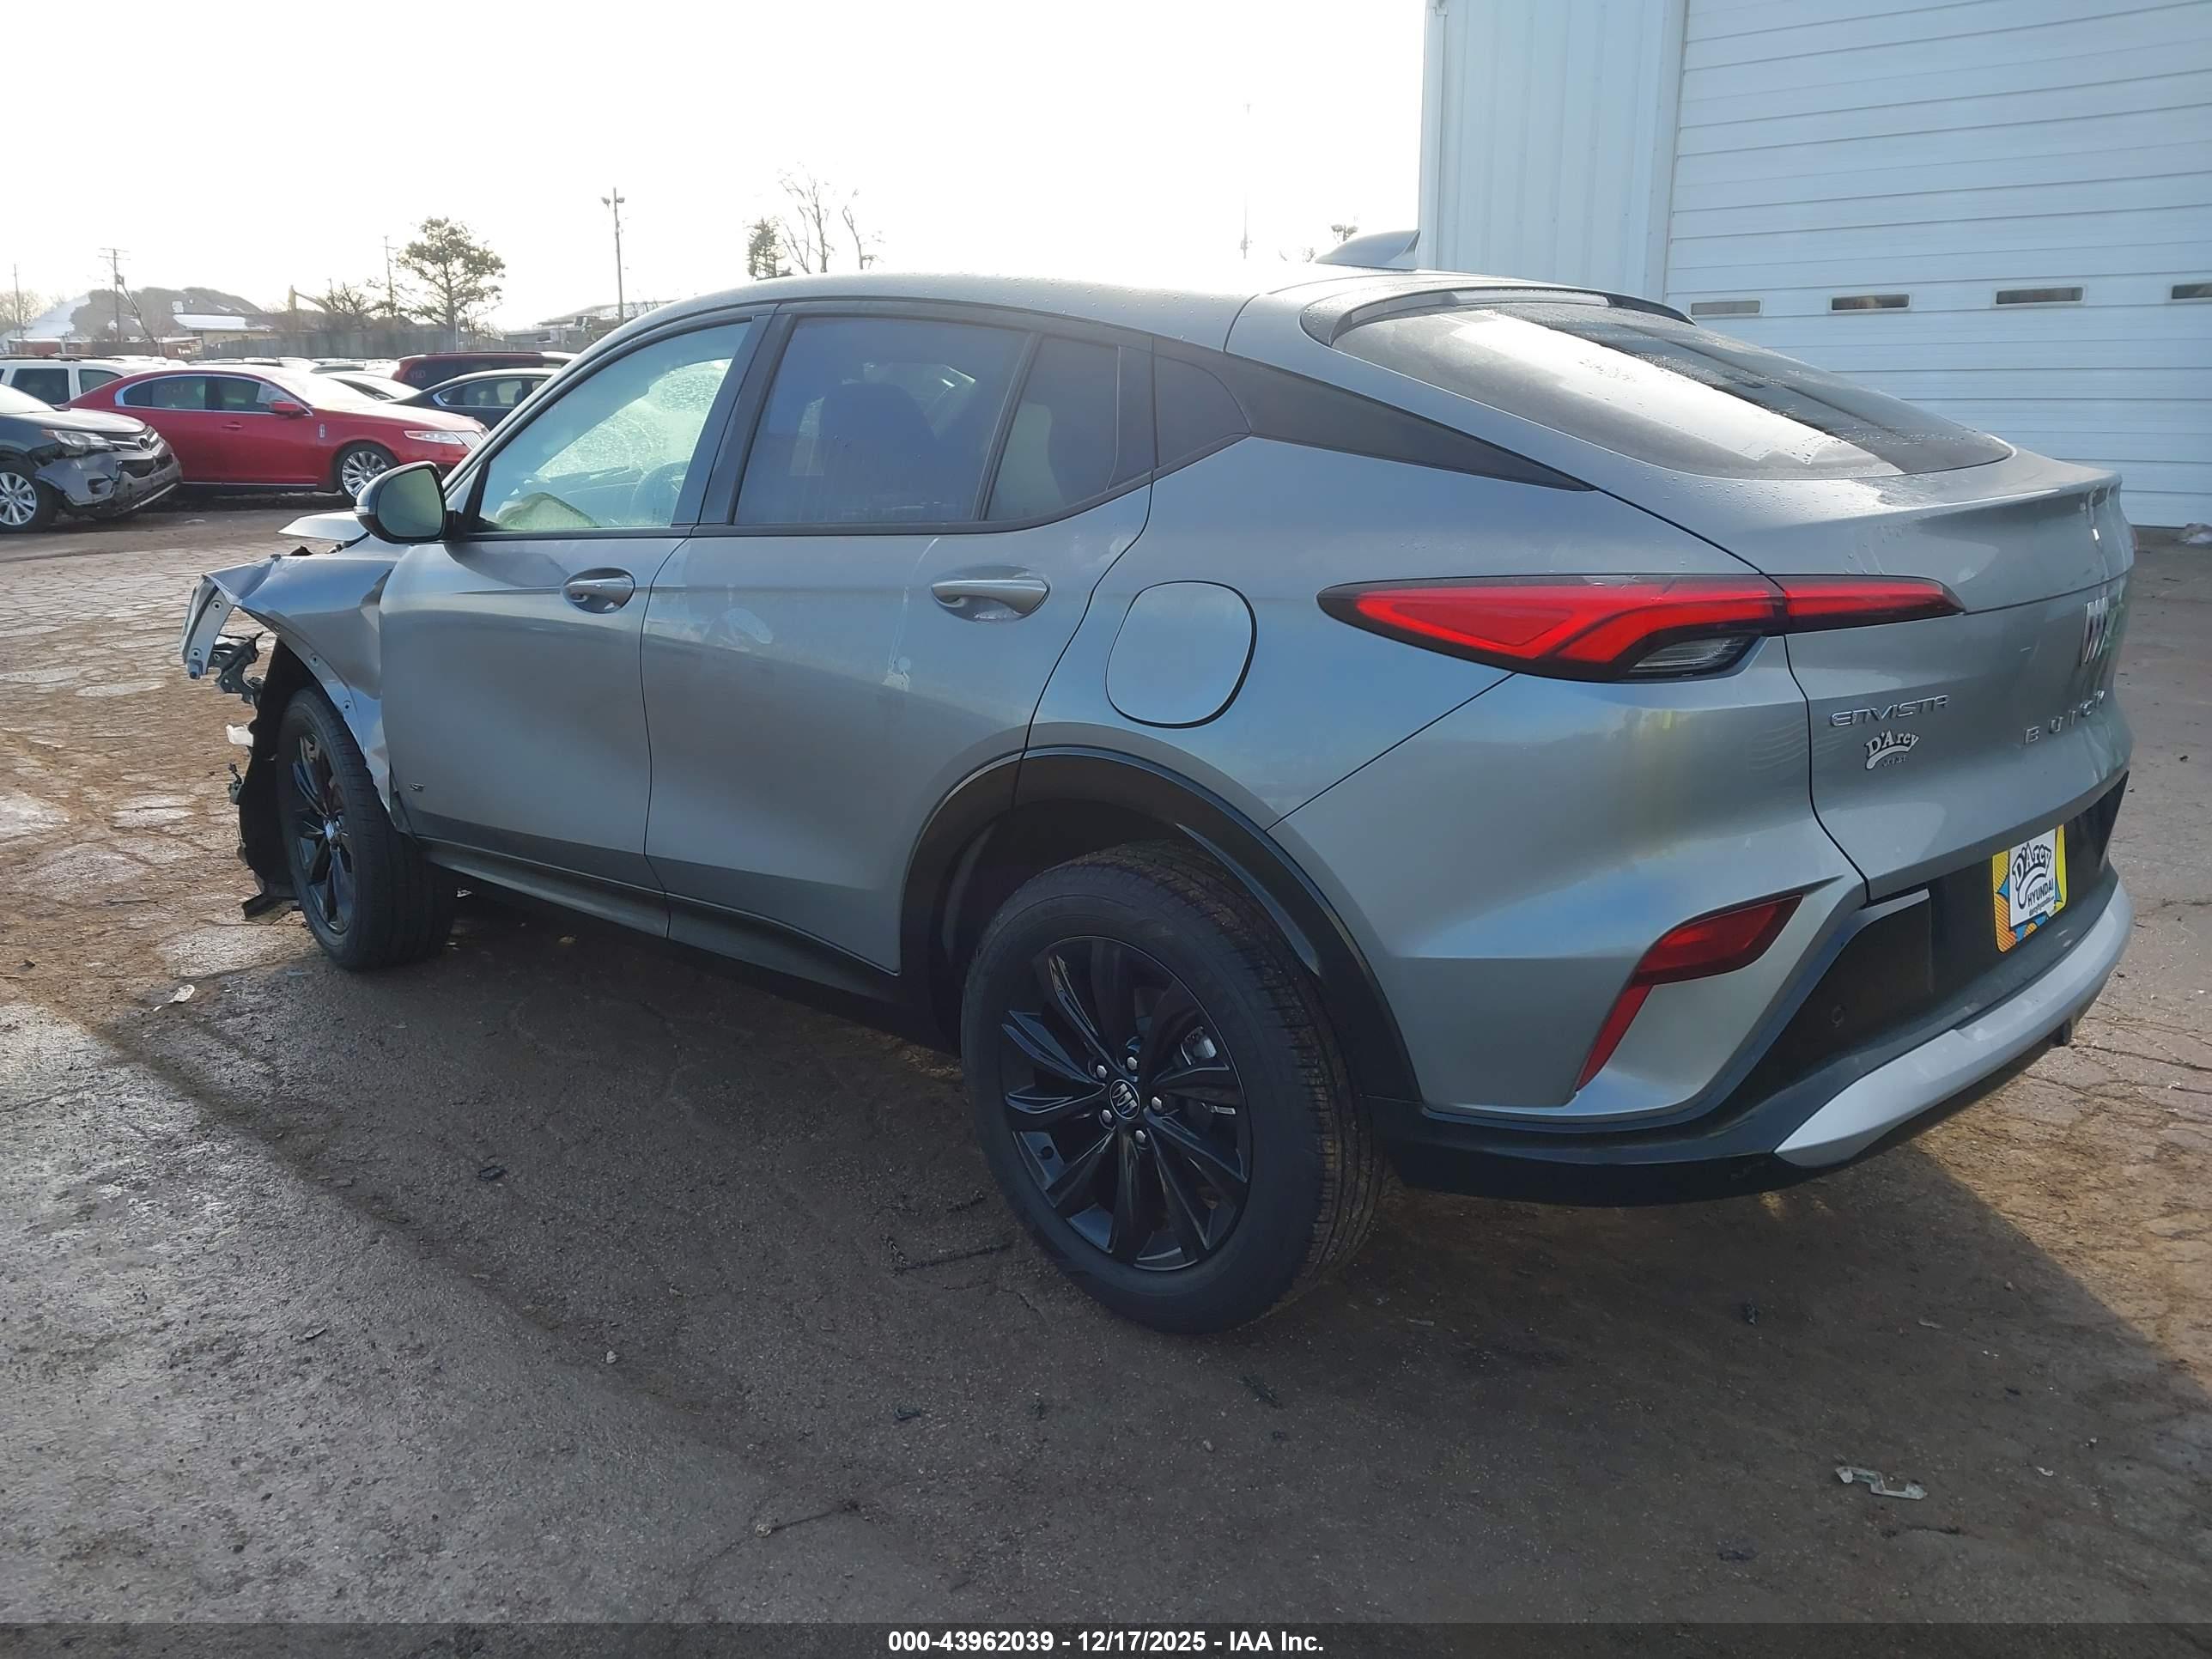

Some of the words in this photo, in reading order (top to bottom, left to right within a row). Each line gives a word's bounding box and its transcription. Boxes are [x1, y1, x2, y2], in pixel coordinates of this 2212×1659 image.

[1830, 694, 1950, 728] ENVISTA
[2024, 690, 2106, 744] BUICK
[1865, 729, 1920, 757] D'Arcy
[2012, 842, 2052, 891] D'Arcy
[2027, 877, 2054, 908] HYUNDAI
